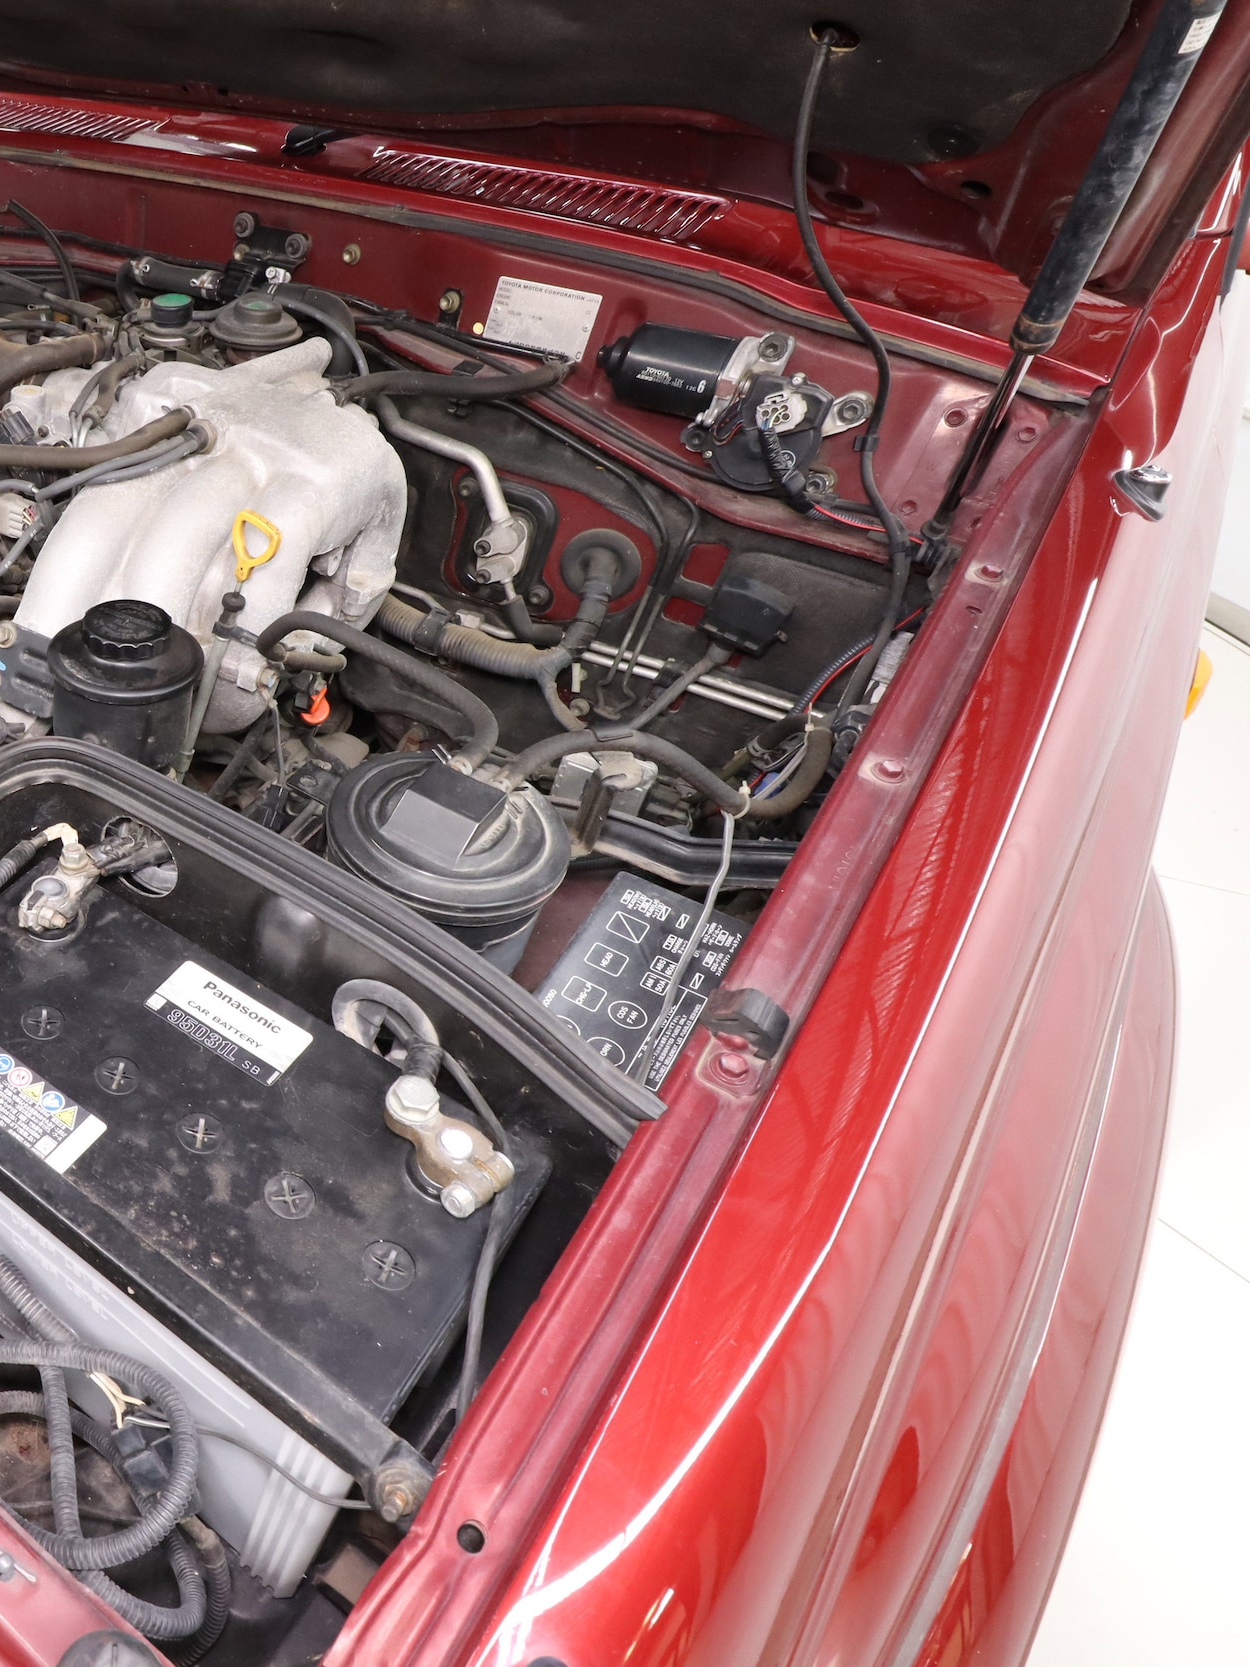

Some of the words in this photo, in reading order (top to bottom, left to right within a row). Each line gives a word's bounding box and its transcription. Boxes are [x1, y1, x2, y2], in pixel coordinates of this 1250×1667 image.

[501, 280, 522, 289] TOYOTA
[523, 285, 543, 293] MOTOR
[544, 288, 585, 301] CORPORATION
[645, 366, 670, 377] TOYOTA
[697, 379, 707, 393] 6
[600, 952, 614, 968] HEAD
[655, 958, 667, 971] ABS
[664, 963, 677, 975] 60A
[654, 980, 667, 992] 50A
[203, 981, 281, 1034] Panasonic
[616, 1006, 629, 1019] CDS
[187, 1000, 210, 1017] CAR
[212, 1015, 263, 1049] BATTERY
[626, 1010, 639, 1025] FAN
[166, 1008, 239, 1061] 95D31L
[241, 1060, 261, 1075] SB
[600, 1043, 613, 1057] ORN
